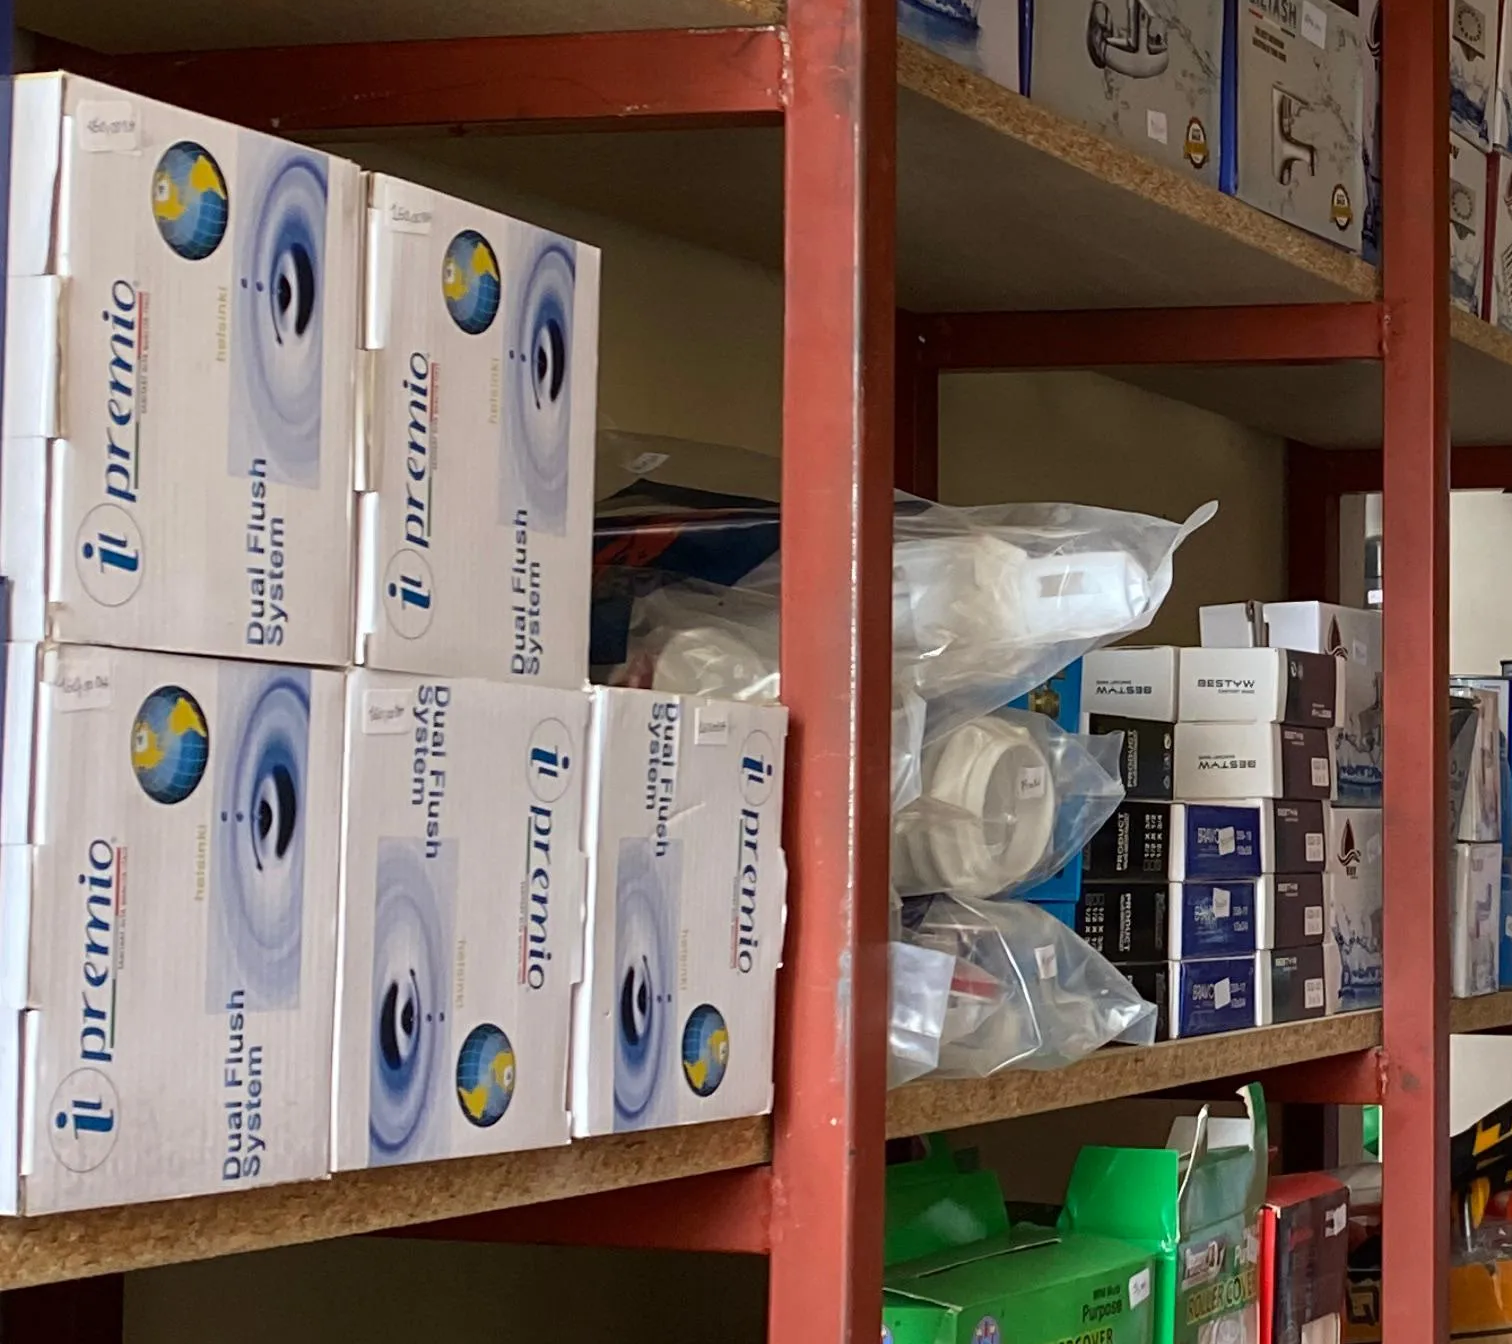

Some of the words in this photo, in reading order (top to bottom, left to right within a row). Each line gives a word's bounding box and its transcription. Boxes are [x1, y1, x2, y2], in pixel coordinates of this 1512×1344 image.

[105, 278, 137, 504] premio
[400, 351, 429, 549] premio
[246, 458, 267, 554] Flush
[511, 509, 528, 589] Flush
[246, 567, 267, 646] Dual
[266, 517, 288, 647] System
[524, 561, 540, 676] System
[511, 596, 527, 676] Dual
[431, 684, 451, 756] Dual
[1096, 685, 1151, 695] BESTYW
[1198, 679, 1255, 689] BESTYW
[411, 684, 432, 806] System
[646, 702, 665, 810] System
[662, 702, 679, 767] Dual
[1198, 759, 1256, 770] BESTYW
[426, 770, 447, 859] Flush
[656, 779, 675, 857] Flush
[1116, 813, 1125, 871] PRODUCT
[528, 805, 554, 991] premio
[739, 809, 760, 976] premio
[80, 838, 115, 1063] premio
[224, 989, 245, 1088] Flush
[223, 1091, 243, 1181] Dual
[244, 1045, 263, 1178] System
[1082, 1300, 1123, 1323] Purpose
